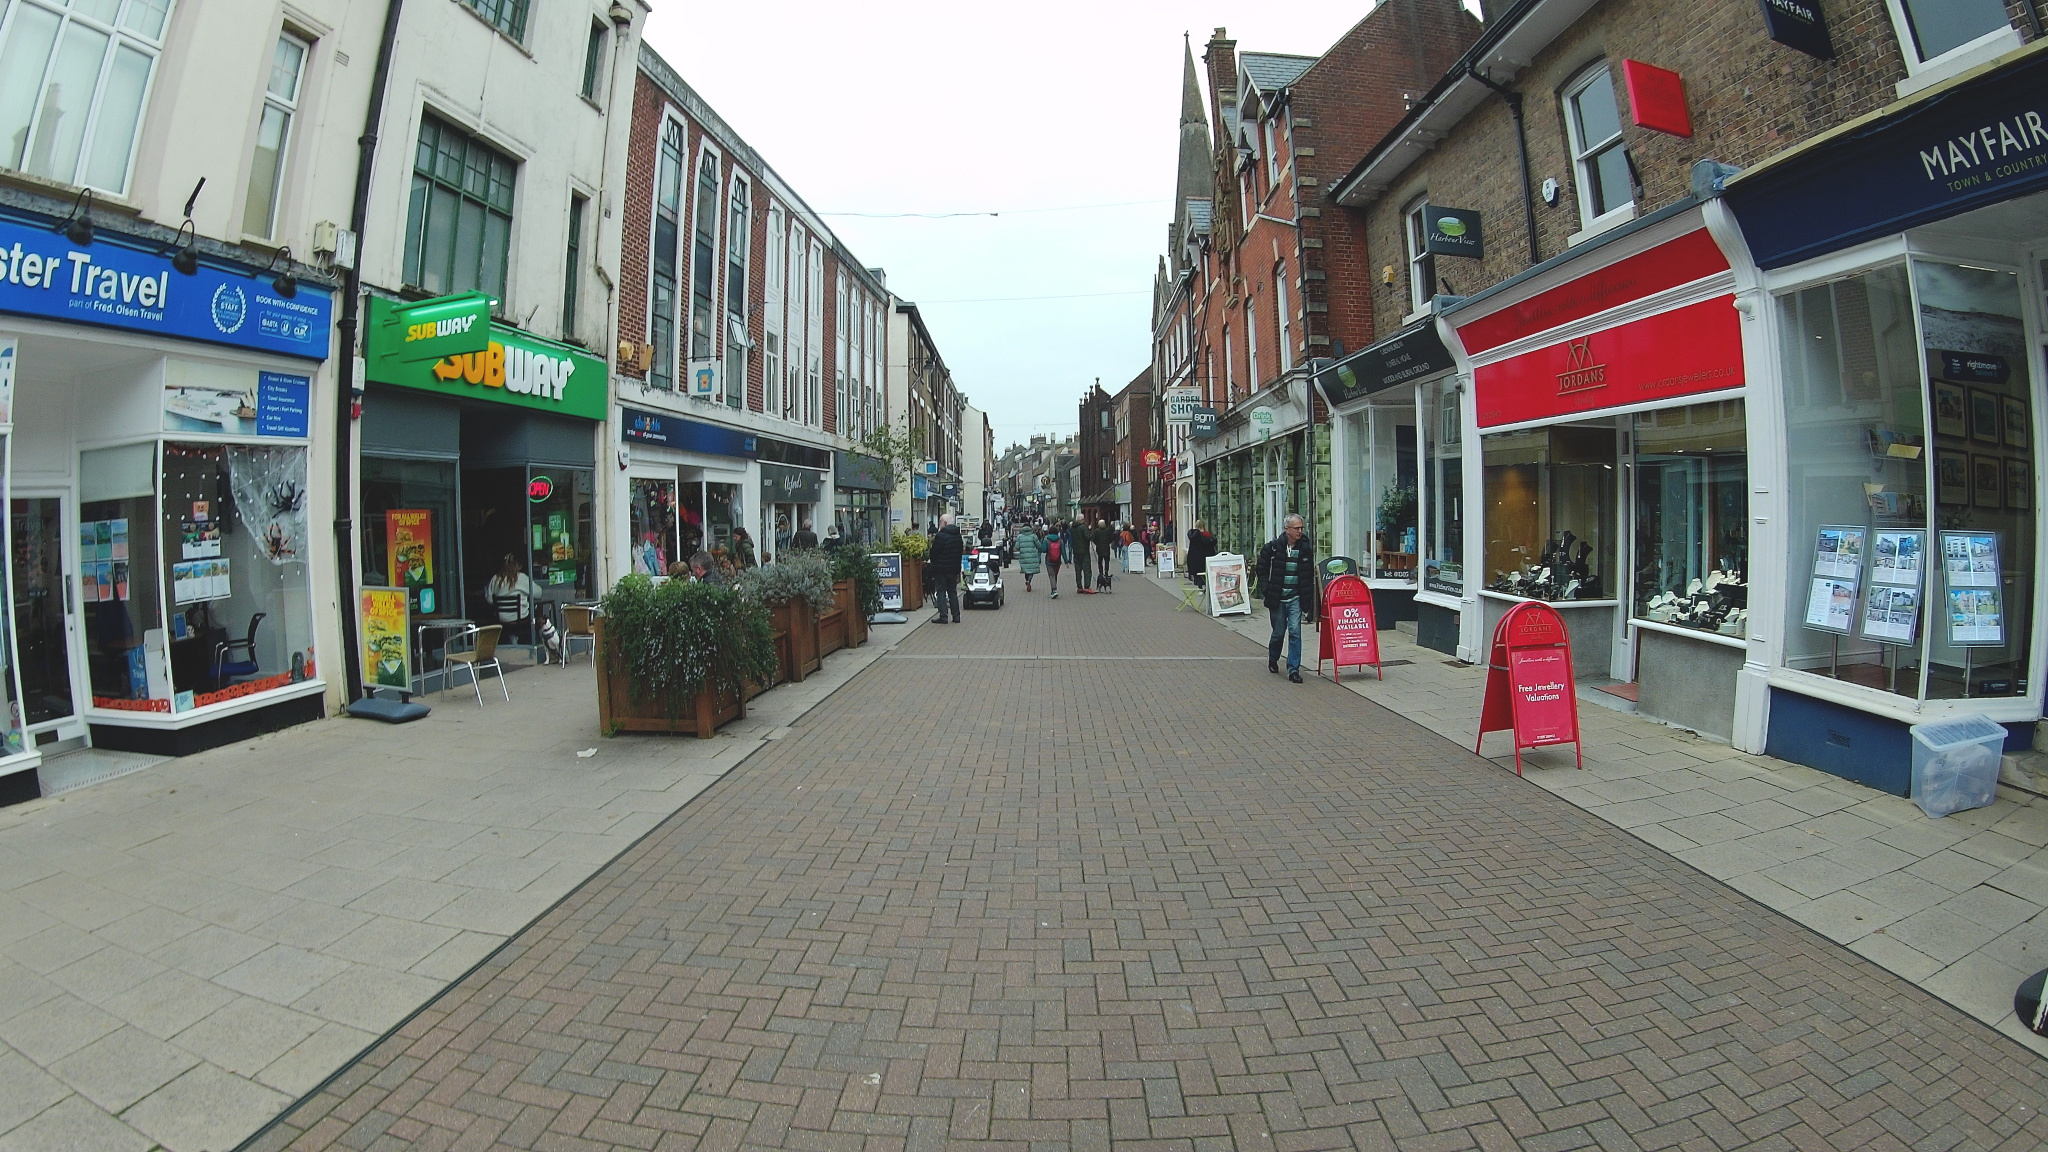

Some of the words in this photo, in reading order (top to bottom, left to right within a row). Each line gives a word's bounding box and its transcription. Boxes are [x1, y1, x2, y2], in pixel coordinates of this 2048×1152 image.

[1767, 0, 1815, 21] AYFAIR
[1920, 111, 2048, 180] MAYFAIR
[1947, 175, 1980, 193] TOWN
[1984, 172, 1992, 182] &
[1996, 153, 2048, 178] COUNTRY
[1430, 233, 1459, 243] Harbour
[67, 250, 169, 309] Travel
[68, 299, 82, 308] part
[85, 301, 93, 309] of
[93, 300, 114, 313] Fred.
[116, 304, 139, 317] Olsen
[140, 308, 163, 322] Travel
[255, 294, 272, 304] BOOK
[272, 298, 286, 309] WITH
[286, 301, 319, 316] CONFIDENCE
[405, 313, 478, 342] SUBWAY
[1559, 368, 1604, 390] JORDANS
[1170, 395, 1200, 403] GARDEN
[1194, 413, 1215, 423] sgm
[1253, 411, 1272, 420] Drink
[528, 482, 550, 496] OPEN
[1343, 608, 1360, 618] 0%
[1336, 622, 1370, 631] AVAILABLE
[1338, 617, 1366, 625] FINANCE
[1518, 684, 1533, 693] Free
[1534, 681, 1565, 691] Jewellery
[1525, 693, 1560, 702] Valuations
